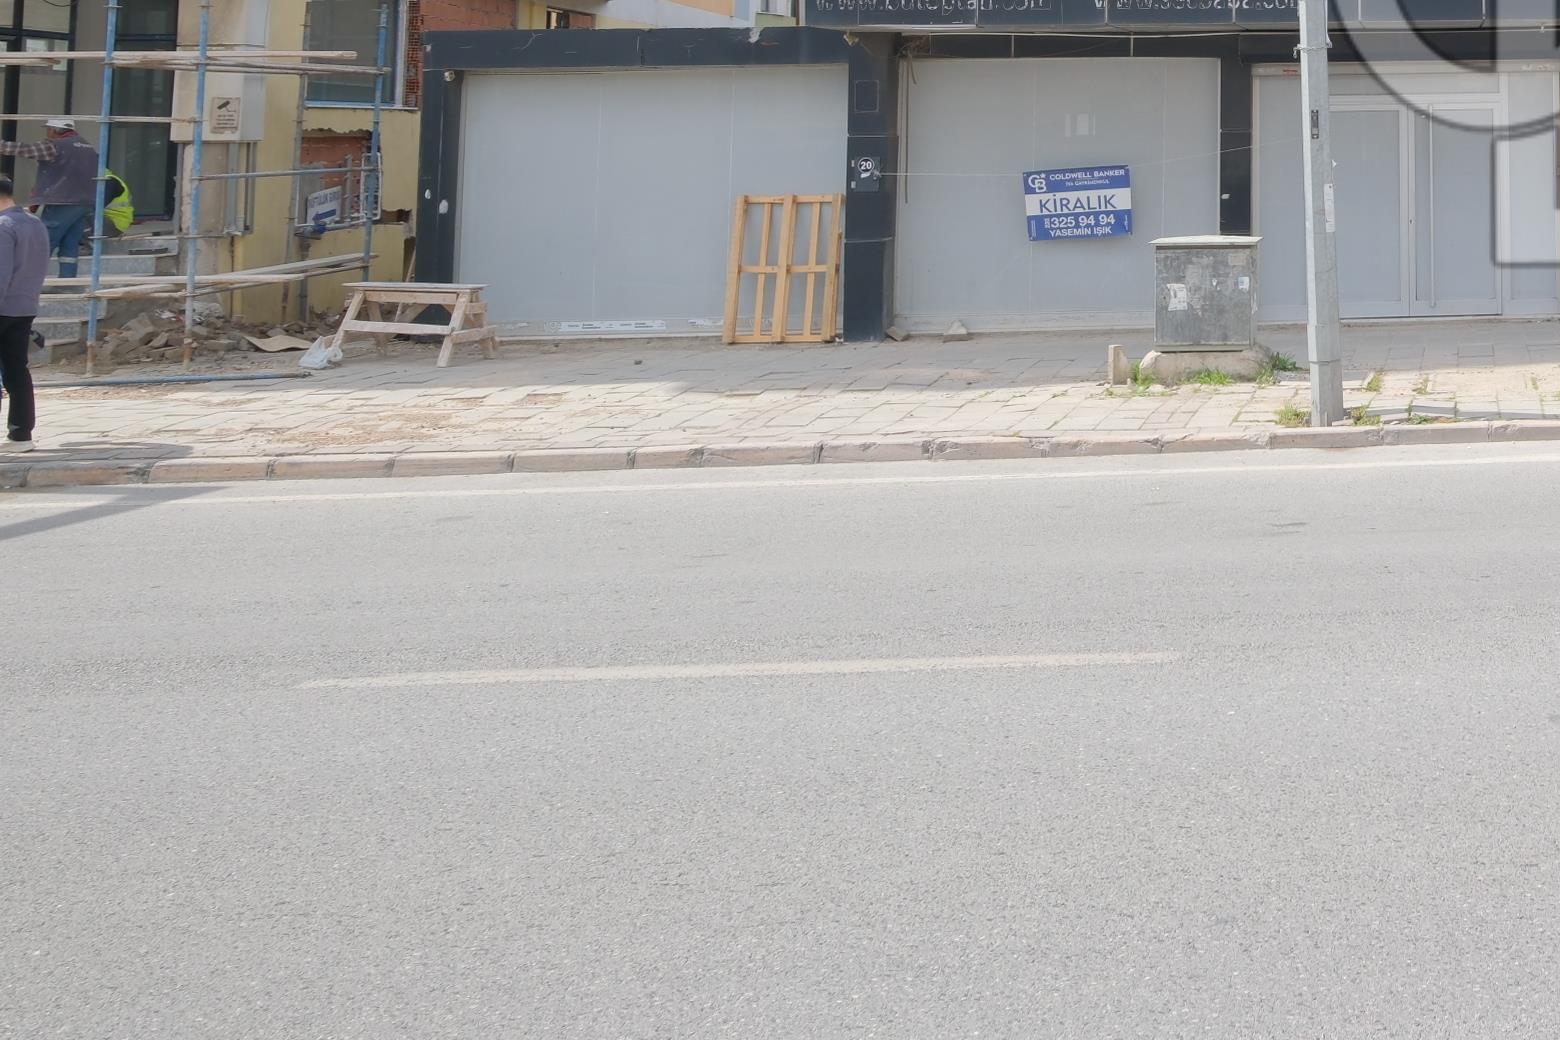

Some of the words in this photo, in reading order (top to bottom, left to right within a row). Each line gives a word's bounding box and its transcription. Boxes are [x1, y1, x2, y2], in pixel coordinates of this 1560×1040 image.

[860, 161, 872, 170] 20
[1049, 172, 1092, 180] COLDWELL
[1093, 168, 1125, 177] BANKER
[1039, 193, 1117, 214] KİRALIK
[1050, 216, 1075, 228] 325
[1078, 215, 1095, 226] 94
[1098, 214, 1115, 225] 94
[1049, 226, 1092, 237] YASEMİN
